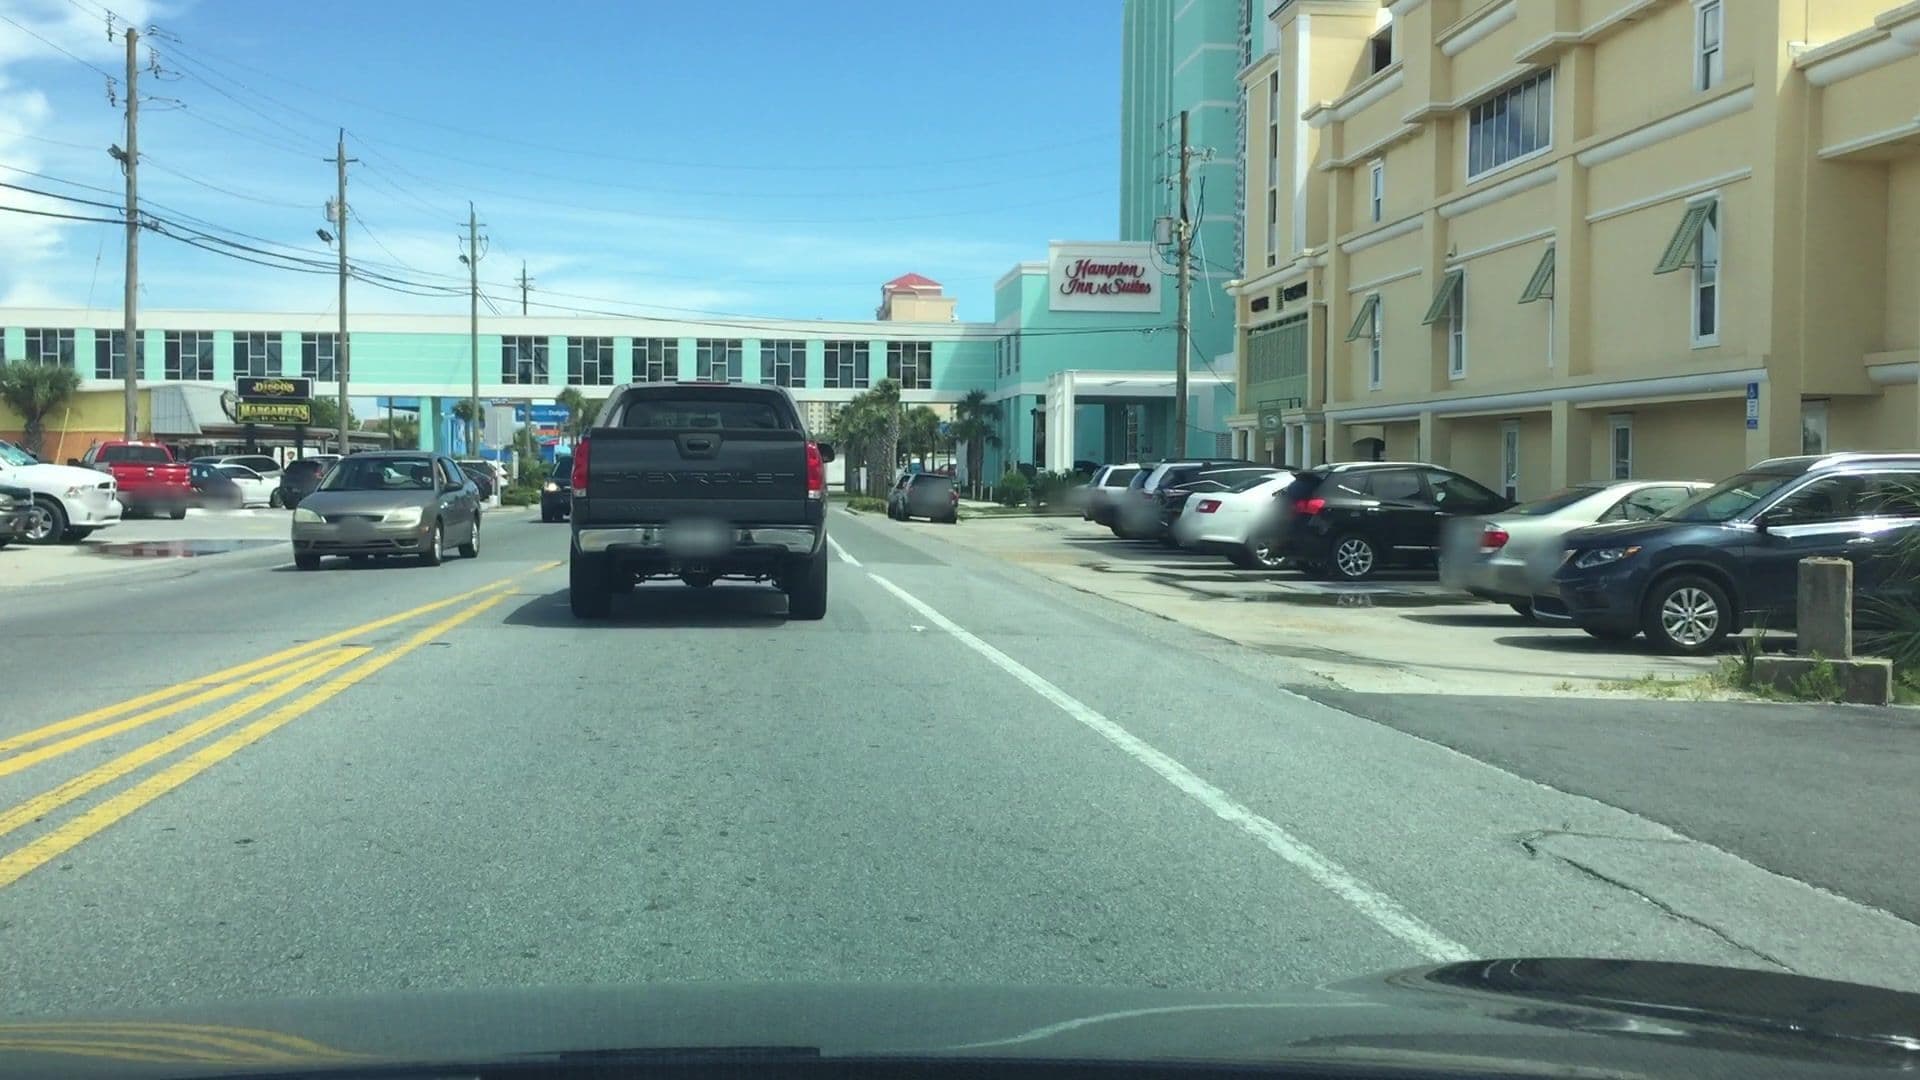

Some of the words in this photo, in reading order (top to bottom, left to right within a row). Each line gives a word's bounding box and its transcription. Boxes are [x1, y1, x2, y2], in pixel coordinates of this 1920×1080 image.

[1065, 259, 1145, 279] Hampton
[1060, 278, 1099, 295] Inn
[1109, 278, 1151, 295] Suites
[601, 471, 796, 487] CHEVROLET
